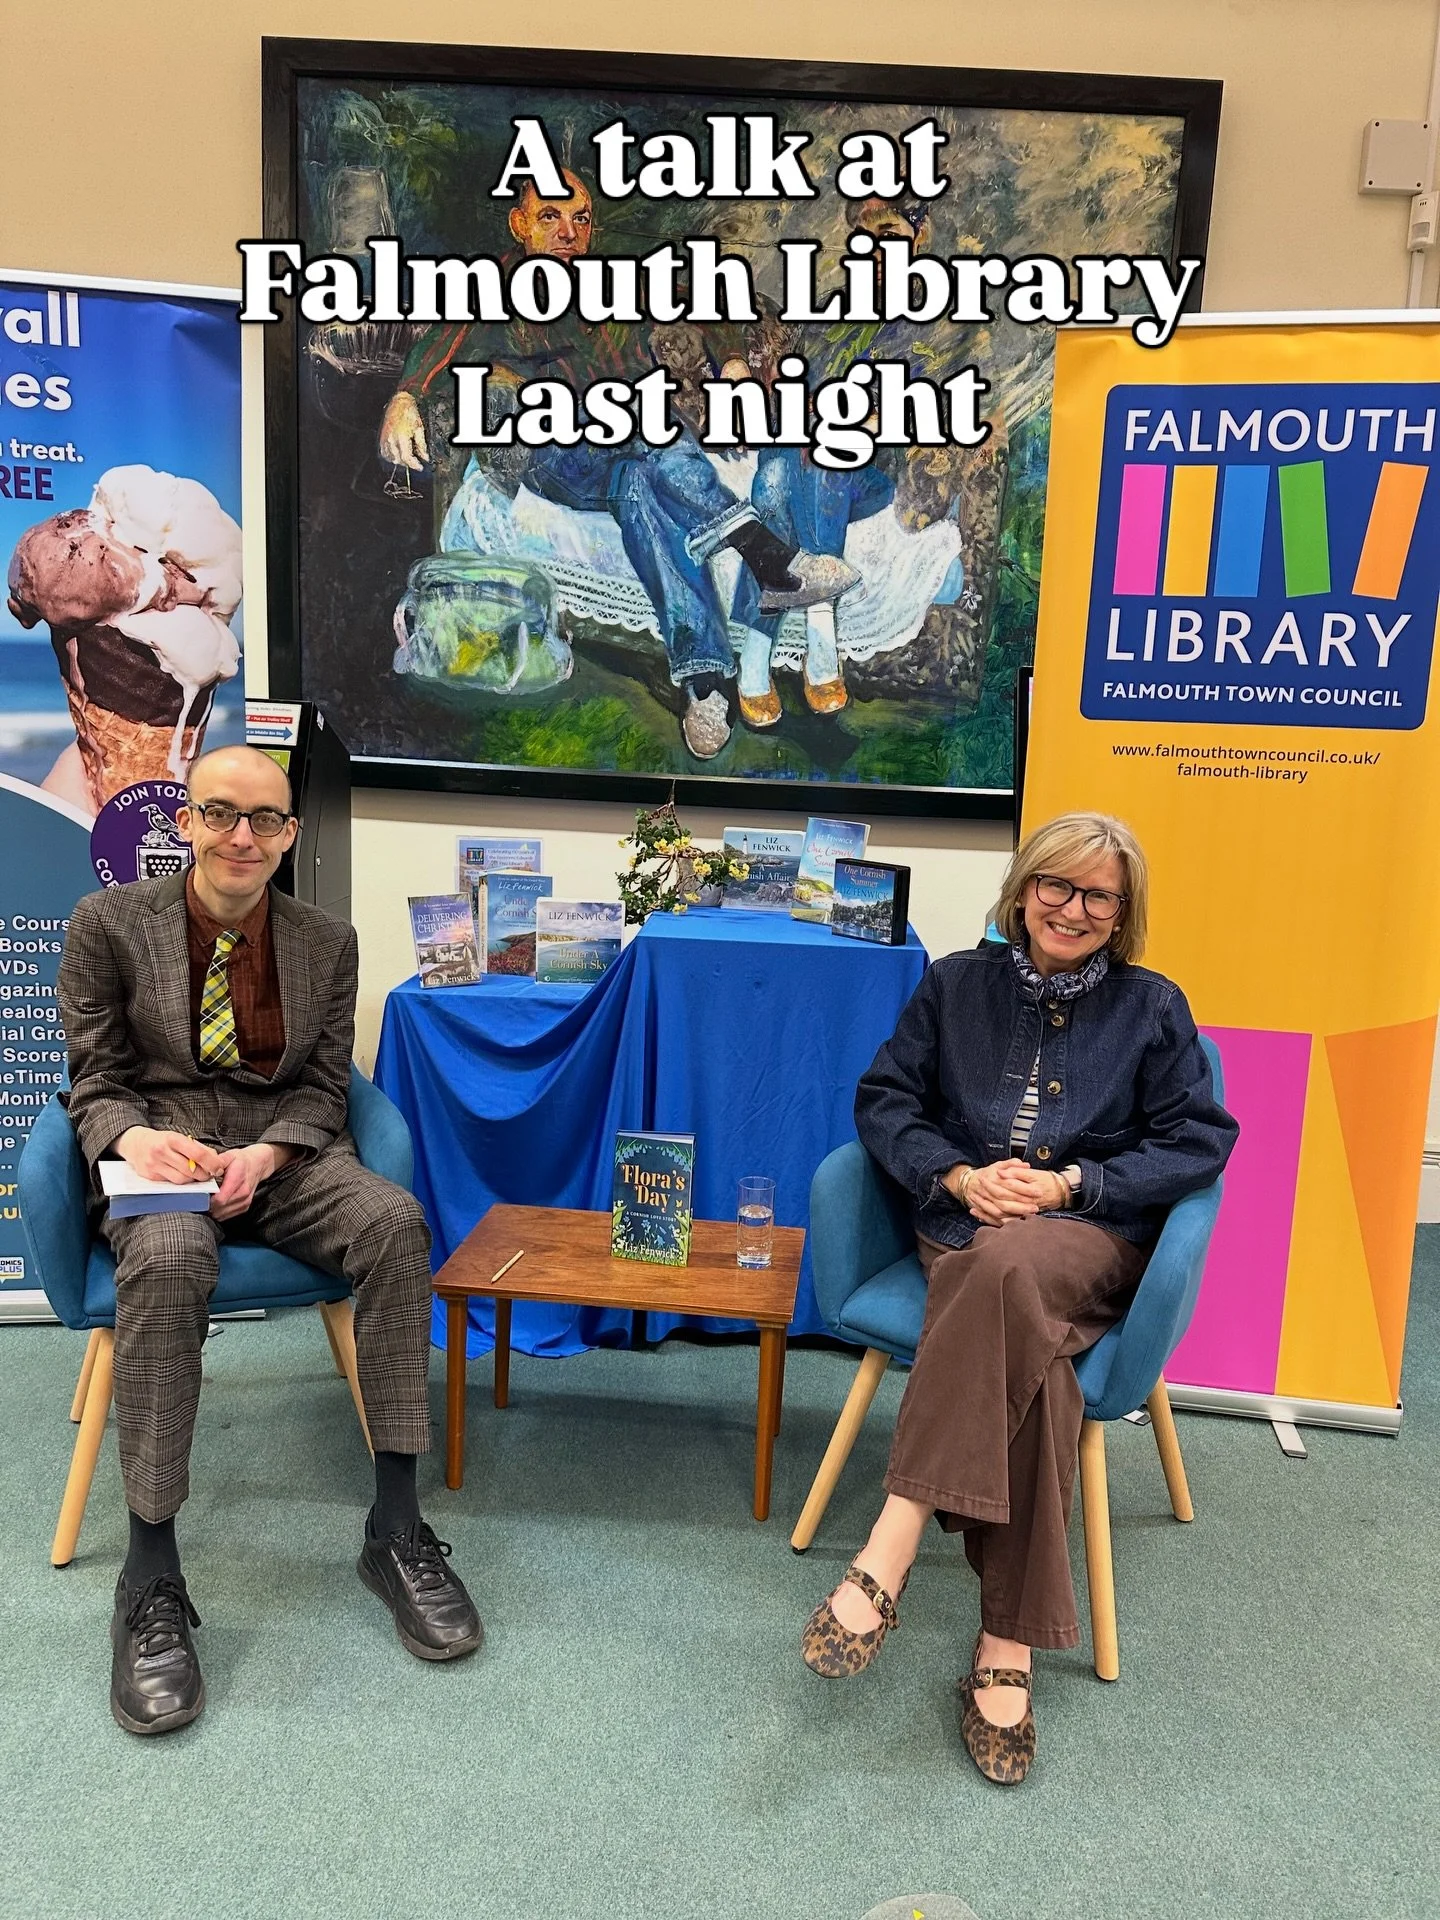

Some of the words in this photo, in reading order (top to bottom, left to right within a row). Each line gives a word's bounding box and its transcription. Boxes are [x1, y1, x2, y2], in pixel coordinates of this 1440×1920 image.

[0, 290, 80, 347] all
[1124, 408, 1437, 452] FALMOUTH
[10, 438, 84, 462] treat.
[1106, 607, 1412, 668] LIBRARY
[1102, 682, 1220, 701] FALMOUTH
[1225, 685, 1295, 703] TOWN
[1300, 687, 1403, 707] COUNCIL
[1111, 743, 1381, 765] www.falmouthtowncouncil.co.uk/
[1177, 763, 1309, 784] falmouth-library
[114, 786, 150, 812] JOIN
[753, 844, 791, 853] FENWICK
[767, 872, 791, 881] Affair
[844, 865, 858, 875] One
[859, 865, 886, 879] Cornish
[853, 887, 889, 900] FENWICK
[417, 911, 467, 924] DELIVERING
[549, 912, 563, 920] LIZ
[566, 912, 612, 921] FENWICK
[550, 959, 587, 969] Cornish
[590, 959, 608, 972] Sky
[621, 1164, 685, 1191] Flora's
[635, 1184, 671, 1213] Day
[624, 1242, 638, 1253] Liz
[640, 1244, 675, 1259] Fenwick
